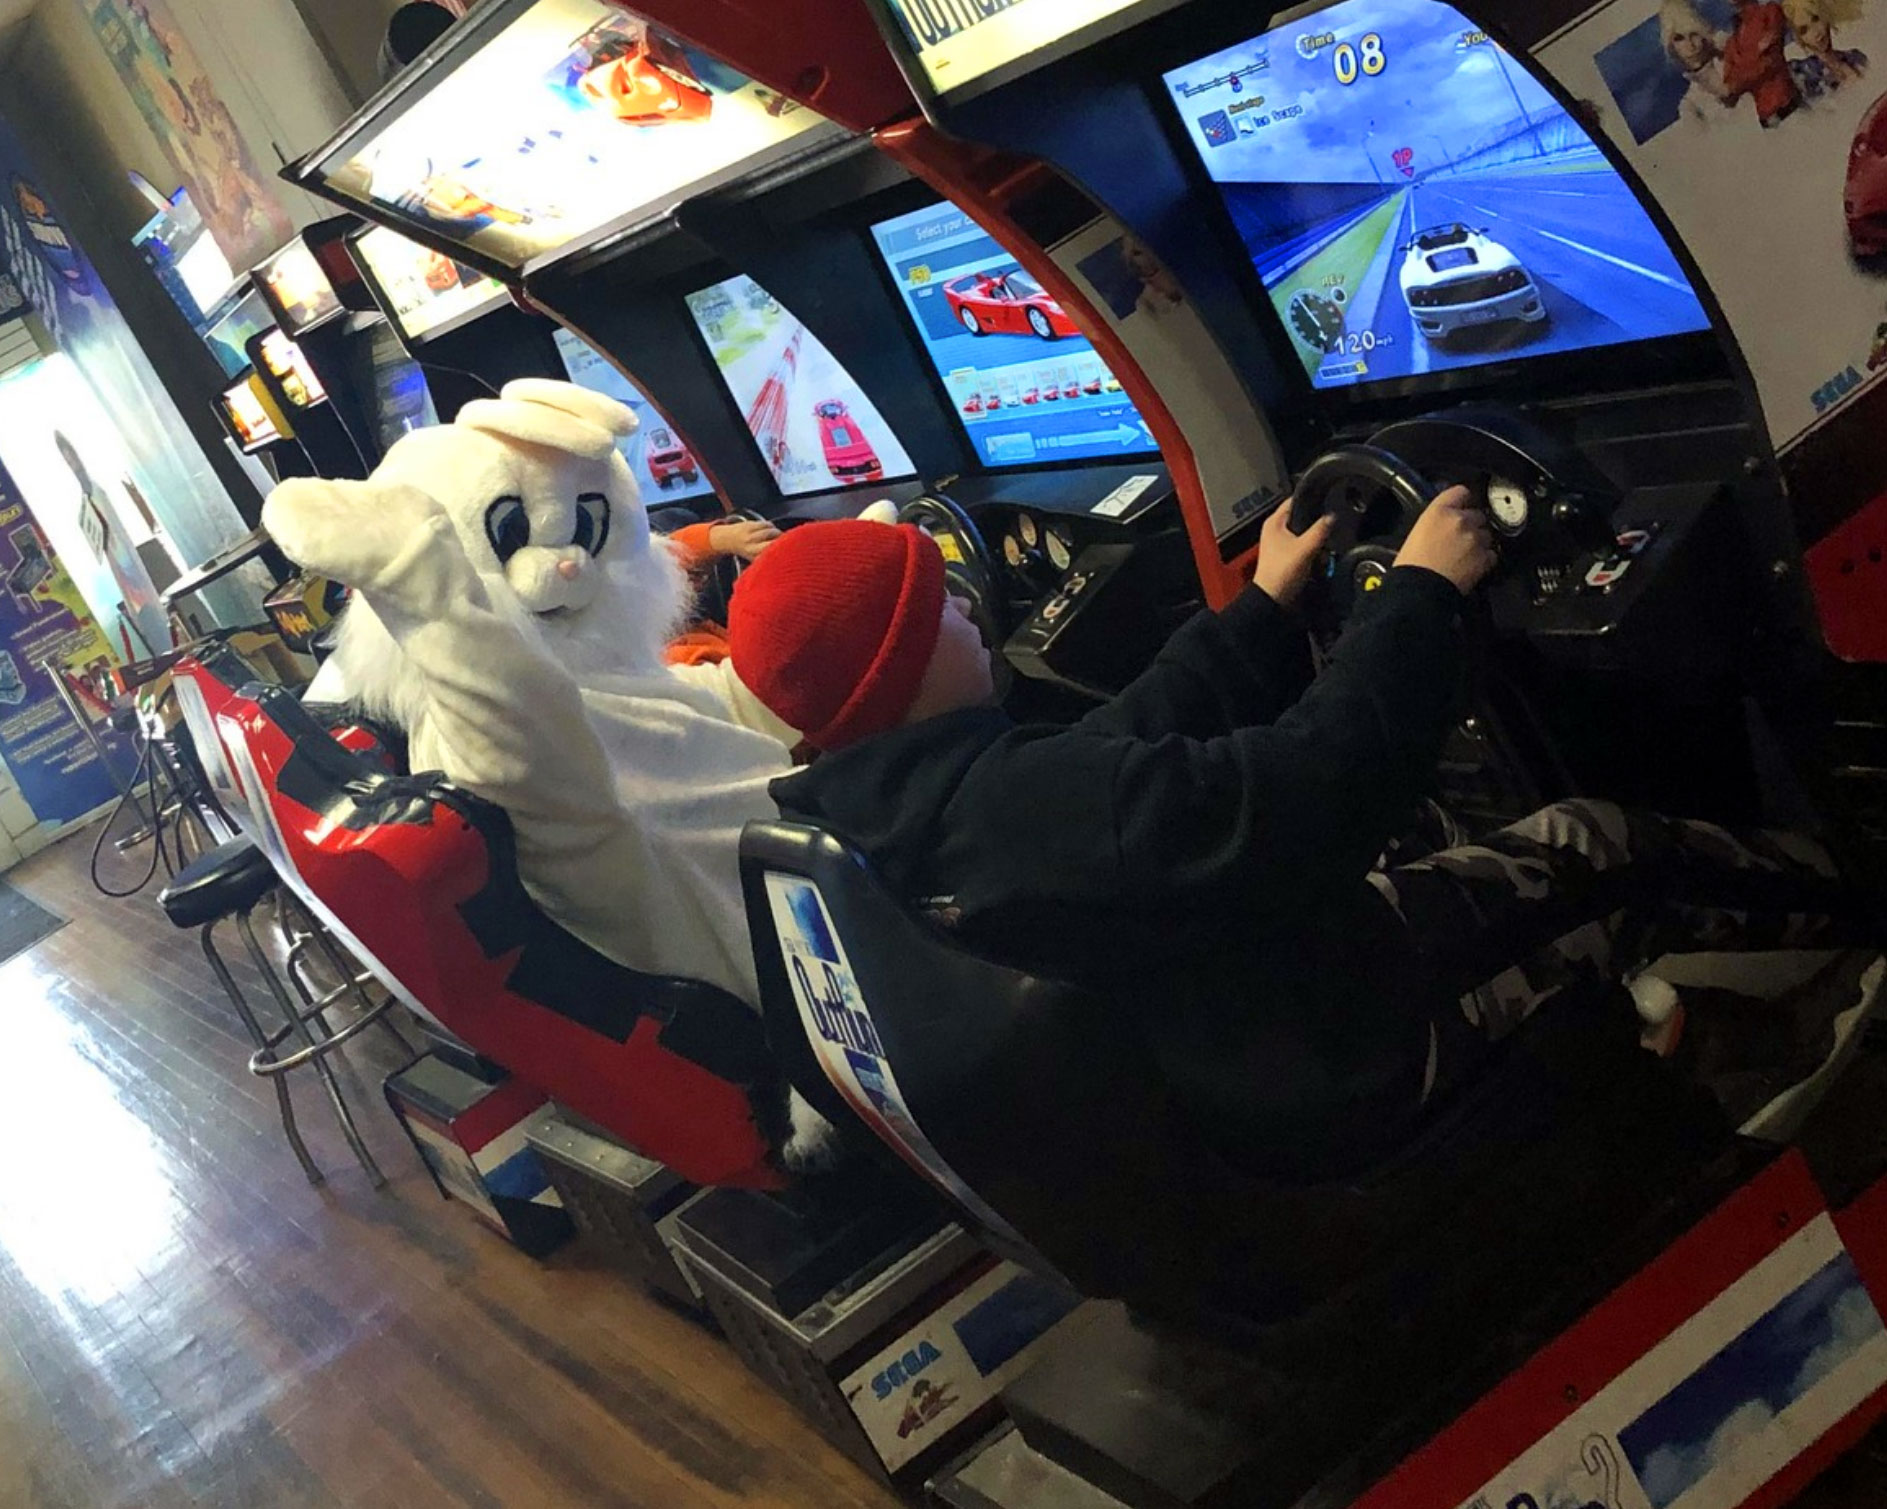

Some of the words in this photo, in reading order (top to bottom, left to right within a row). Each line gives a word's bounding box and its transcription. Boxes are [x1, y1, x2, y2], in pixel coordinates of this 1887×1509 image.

[1302, 32, 1335, 51] Time
[1333, 32, 1387, 85] 08
[1392, 147, 1413, 168] 1P
[871, 1340, 942, 1402] SEGA
